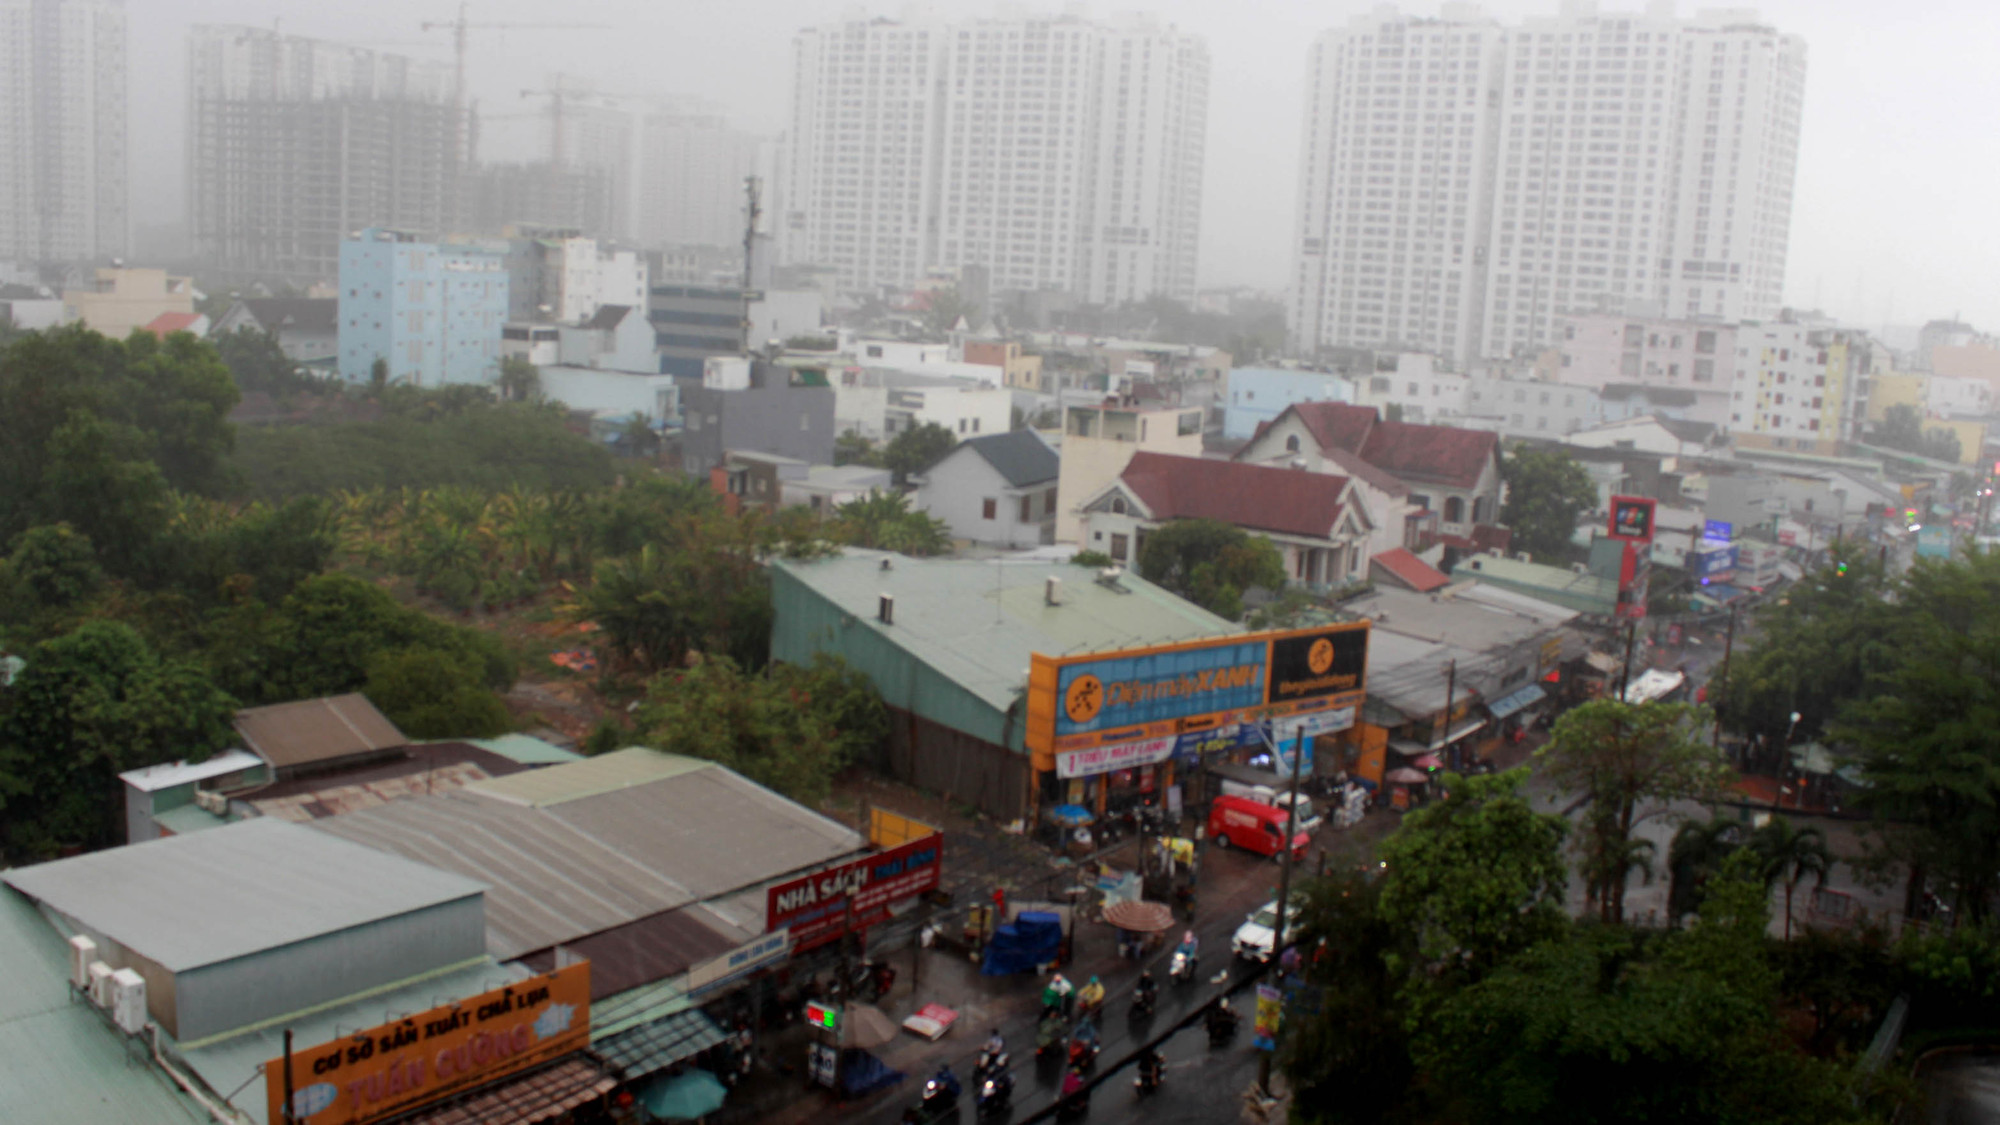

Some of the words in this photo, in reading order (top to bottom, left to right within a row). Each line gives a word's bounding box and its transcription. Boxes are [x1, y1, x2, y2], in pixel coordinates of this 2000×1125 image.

[776, 876, 818, 915] NHÀ
[313, 1047, 342, 1075] CƠ
[425, 1007, 472, 1039] XUẤT
[345, 1053, 425, 1111] TUẤN
[435, 1022, 530, 1079] CƯỜNG
